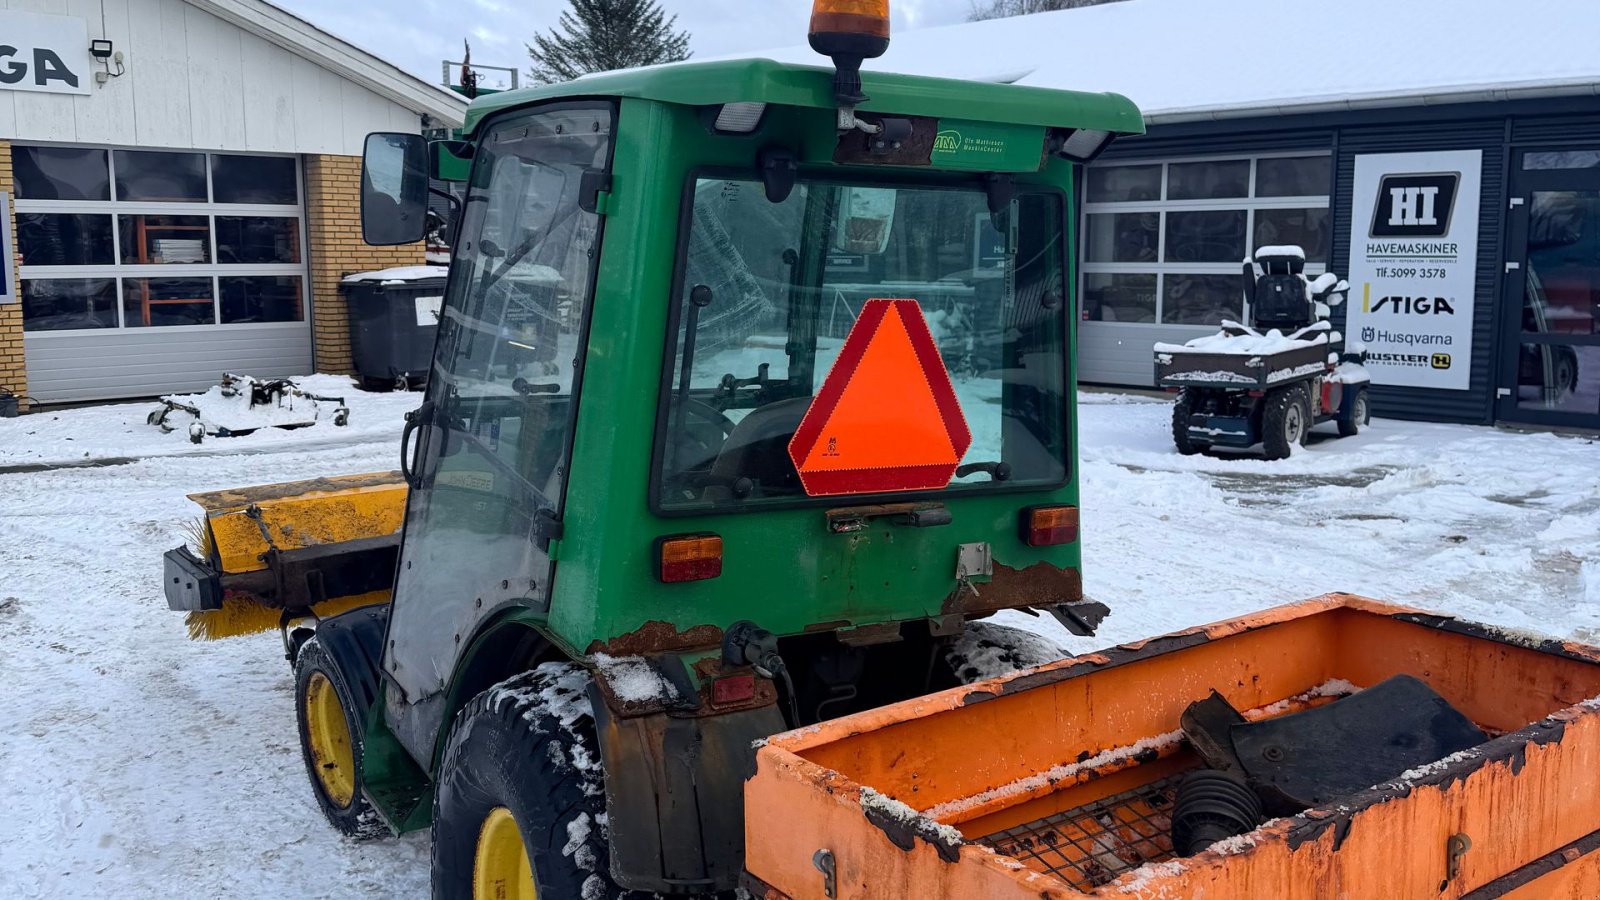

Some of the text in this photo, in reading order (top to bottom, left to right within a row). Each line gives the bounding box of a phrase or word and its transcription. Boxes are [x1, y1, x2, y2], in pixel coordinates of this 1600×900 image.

[1388, 186, 1439, 226] HI
[1366, 243, 1458, 254] HAVEMASKINER
[1419, 268, 1446, 279] 3578
[1370, 296, 1455, 315] STIGA
[1377, 330, 1453, 346] Husqvarna
